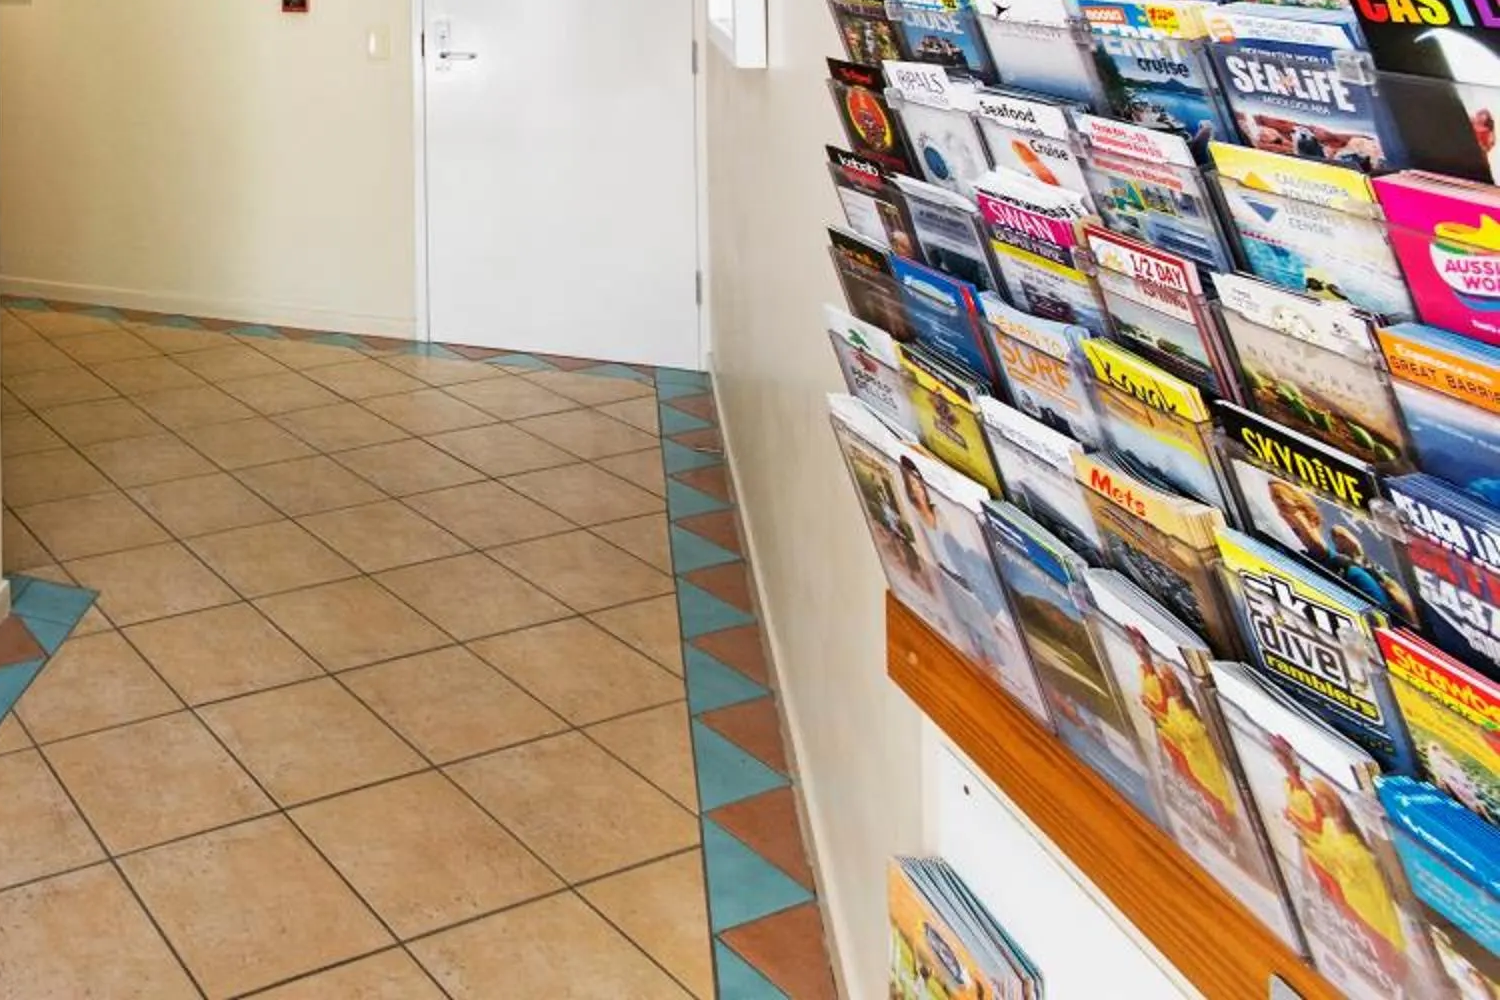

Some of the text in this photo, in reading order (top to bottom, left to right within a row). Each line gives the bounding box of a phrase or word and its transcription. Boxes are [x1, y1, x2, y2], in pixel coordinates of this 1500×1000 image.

[1137, 57, 1190, 79] cruise
[1225, 55, 1289, 97] SEA
[979, 100, 1036, 124] Seafood
[1029, 138, 1070, 161] Cruise
[985, 202, 1060, 243] SWAN
[1128, 253, 1184, 290] 1/2 DAY
[1389, 355, 1437, 382] GREAT
[1260, 612, 1342, 682] dive
[1266, 652, 1378, 721] ramblers
